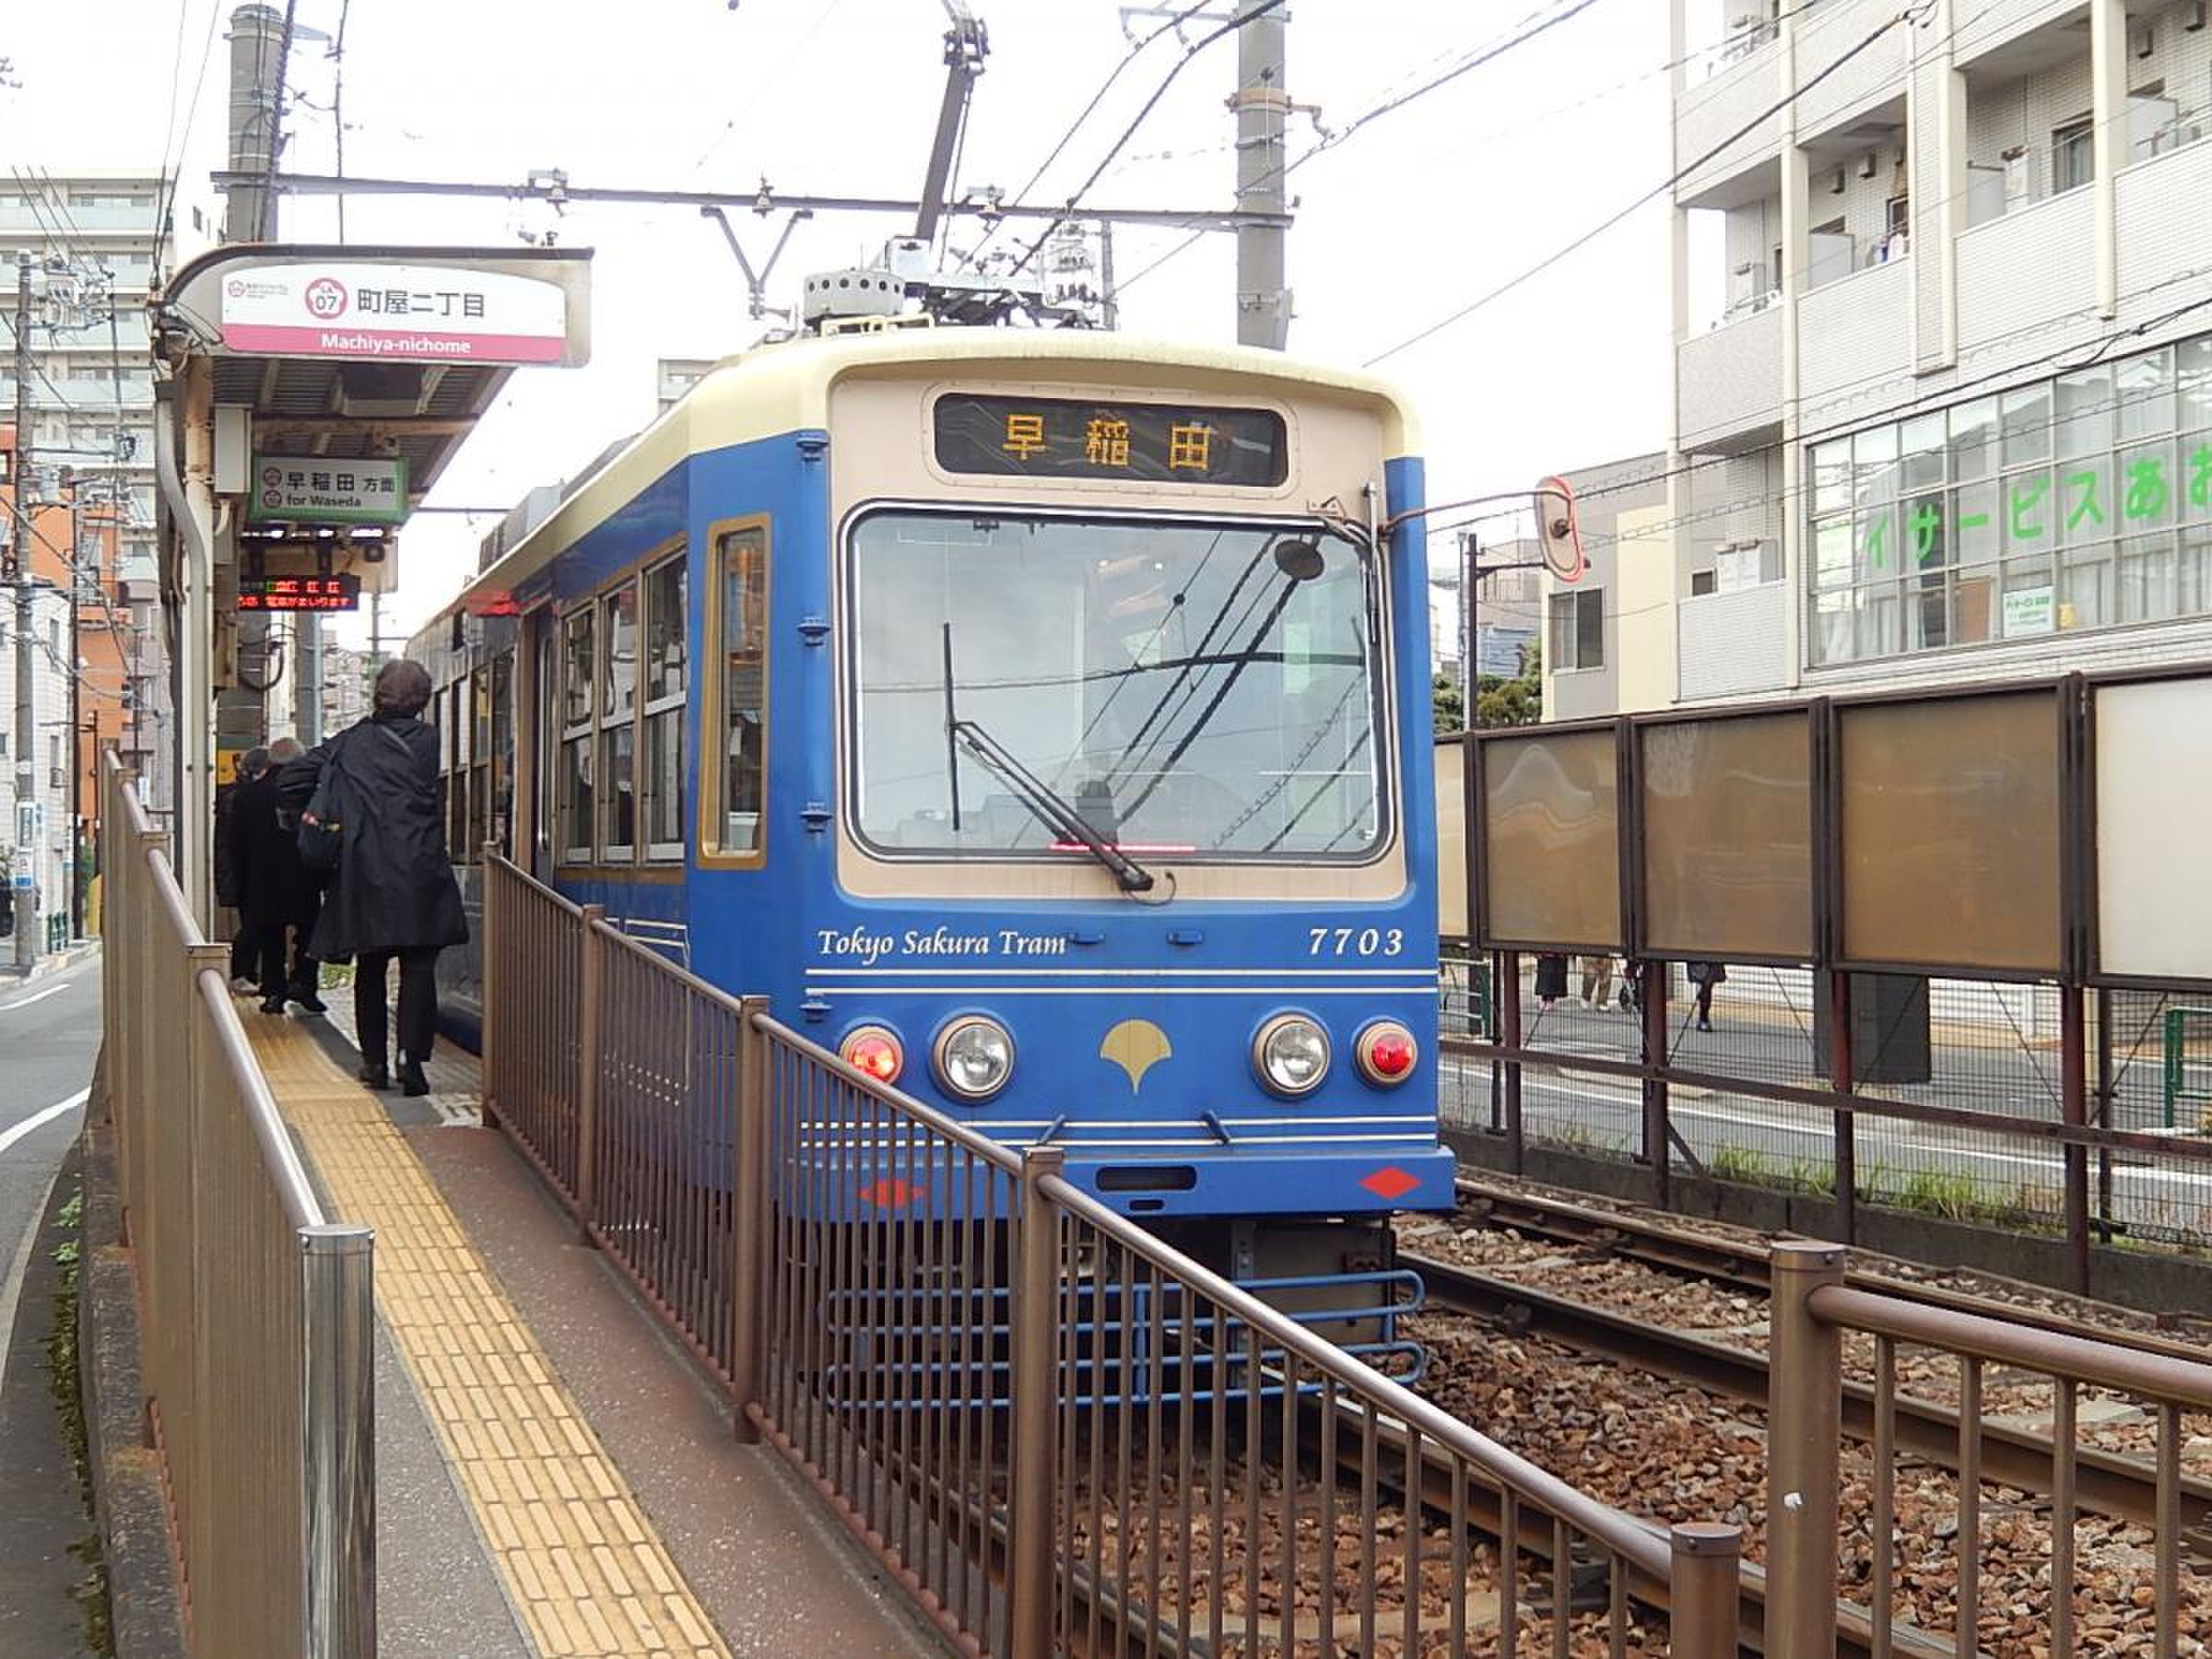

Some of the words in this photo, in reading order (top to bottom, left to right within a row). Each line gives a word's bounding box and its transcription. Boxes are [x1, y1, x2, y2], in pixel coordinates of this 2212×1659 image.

[315, 295, 337, 311] 07
[358, 288, 485, 318] 町屋二丁目
[322, 334, 472, 355] Machiya-nichome
[1002, 413, 1211, 471] 早稲田
[288, 471, 355, 492] 早稲田
[288, 494, 306, 506] for
[310, 495, 361, 507] Waseda
[818, 925, 894, 966] Tokyo
[901, 925, 990, 955] Sakura
[998, 930, 1066, 955] Tram
[1310, 928, 1404, 956] 7703
